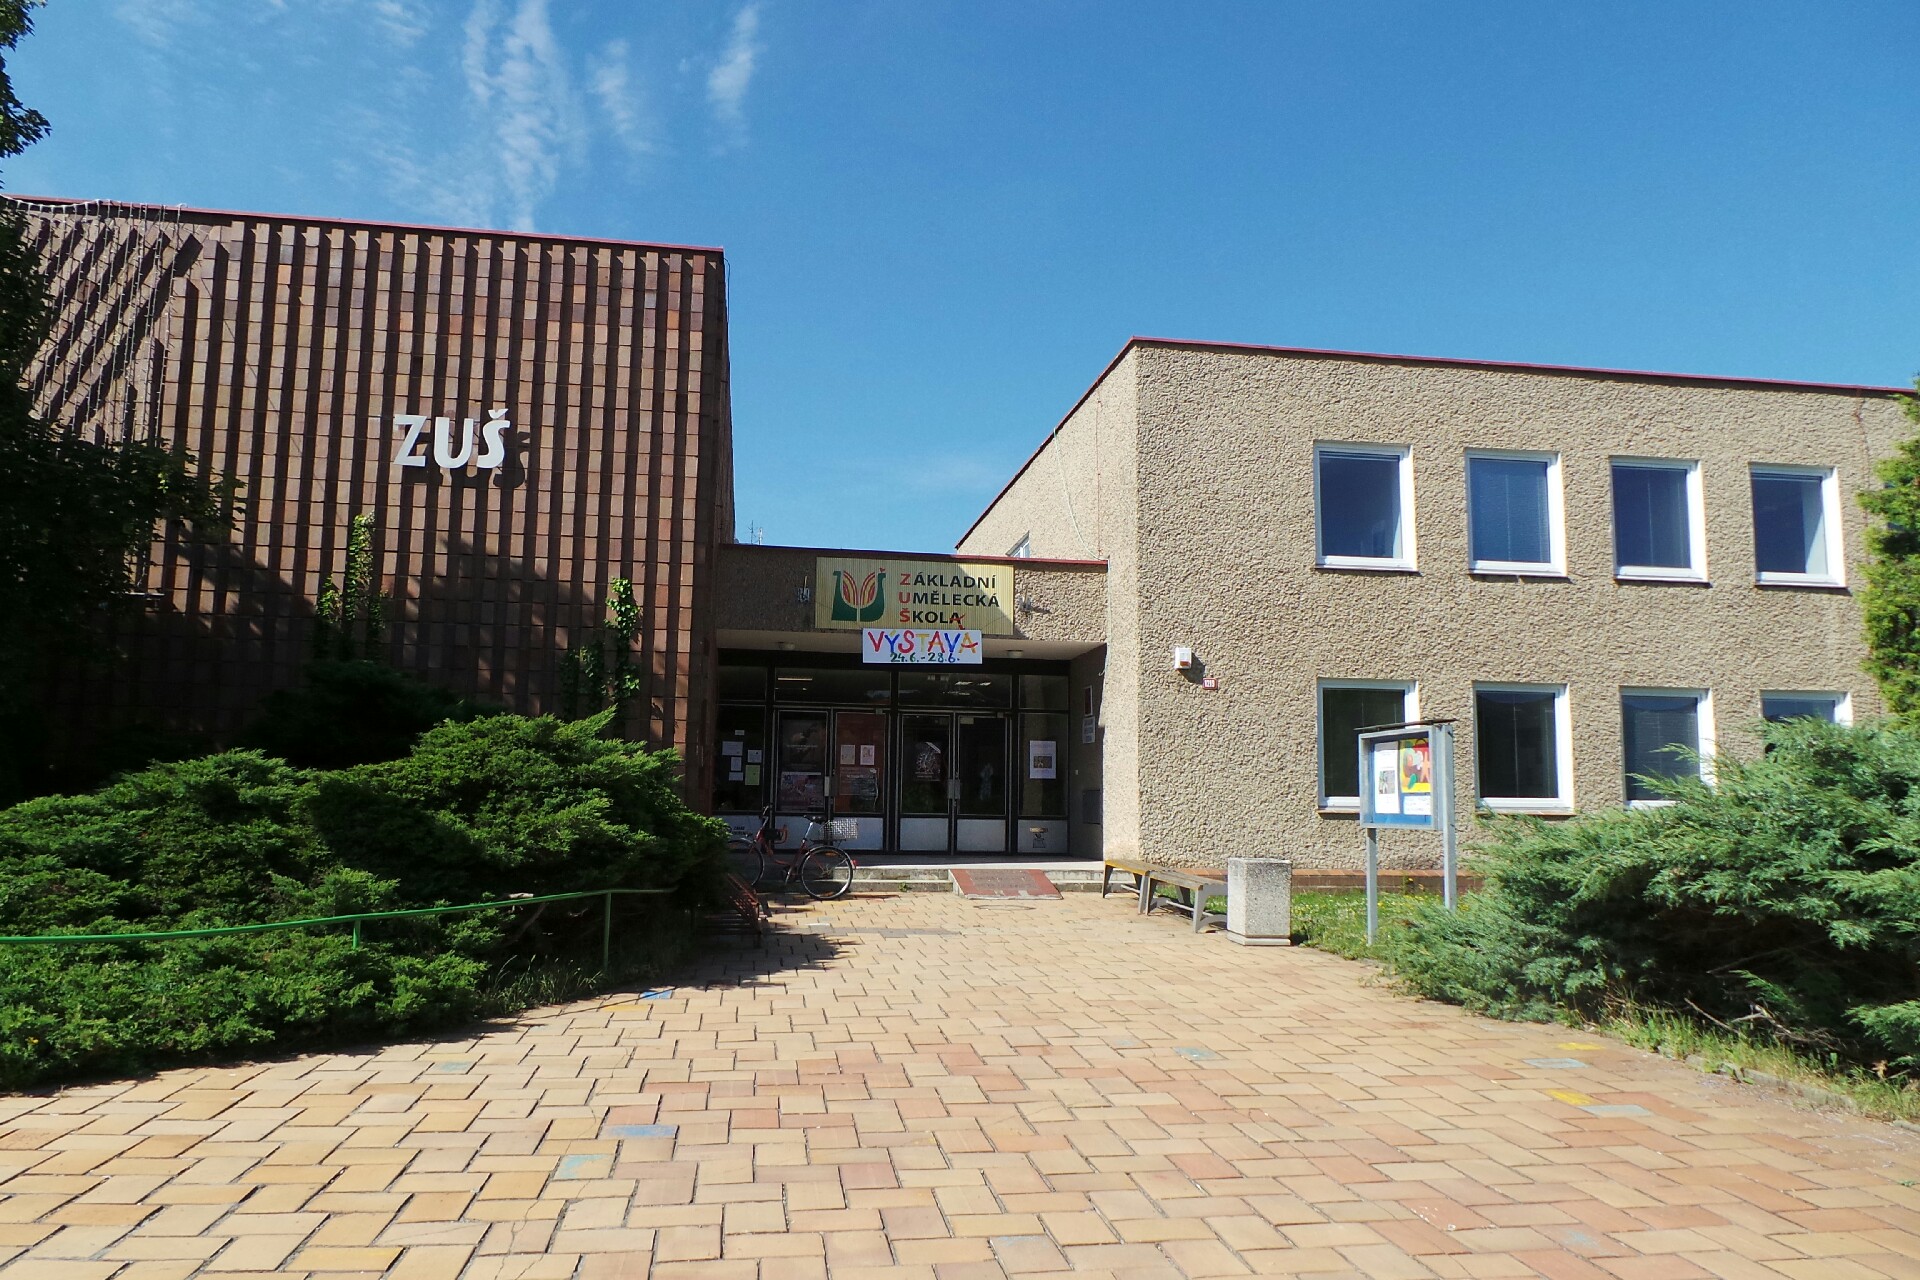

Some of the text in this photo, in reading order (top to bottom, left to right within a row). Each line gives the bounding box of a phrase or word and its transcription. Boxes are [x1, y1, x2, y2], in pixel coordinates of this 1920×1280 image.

[393, 408, 511, 469] ZUŠ
[900, 572, 996, 589] ZÁKLADNÍ
[899, 590, 1000, 607] UMĚLECKÁ
[899, 608, 963, 625] ŠKOLA
[867, 630, 979, 654] VÝSTAVA
